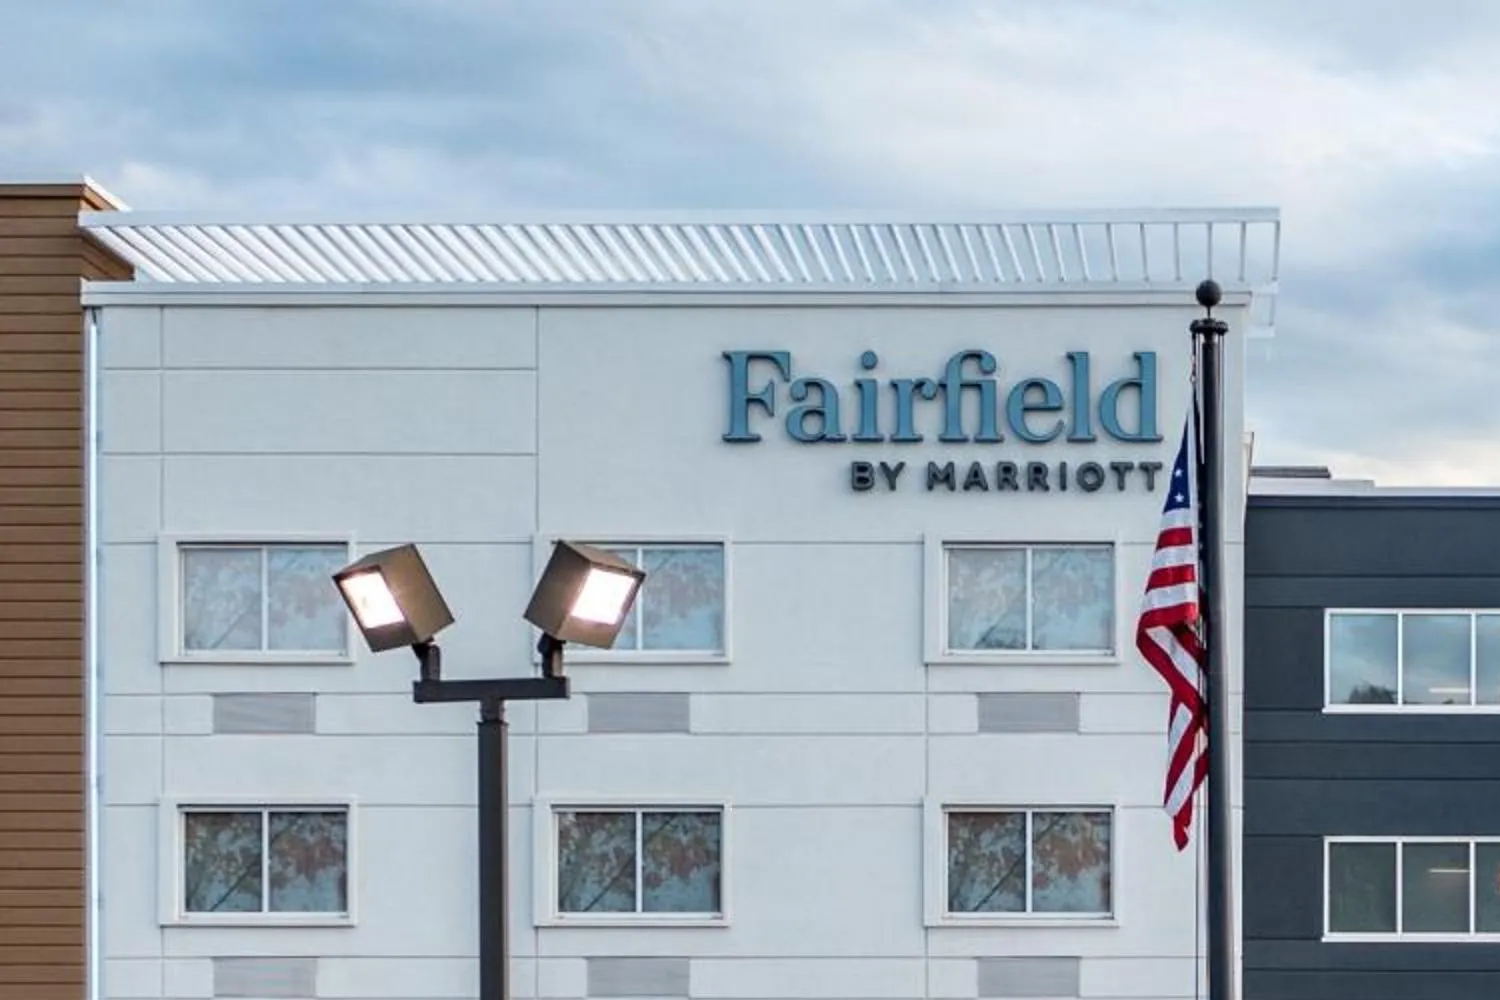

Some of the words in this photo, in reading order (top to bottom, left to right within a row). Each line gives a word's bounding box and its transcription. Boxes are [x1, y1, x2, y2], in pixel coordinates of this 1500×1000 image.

[721, 349, 1164, 444] Fairfield
[849, 460, 906, 492] BY
[924, 460, 1163, 492] MARRIOTT
